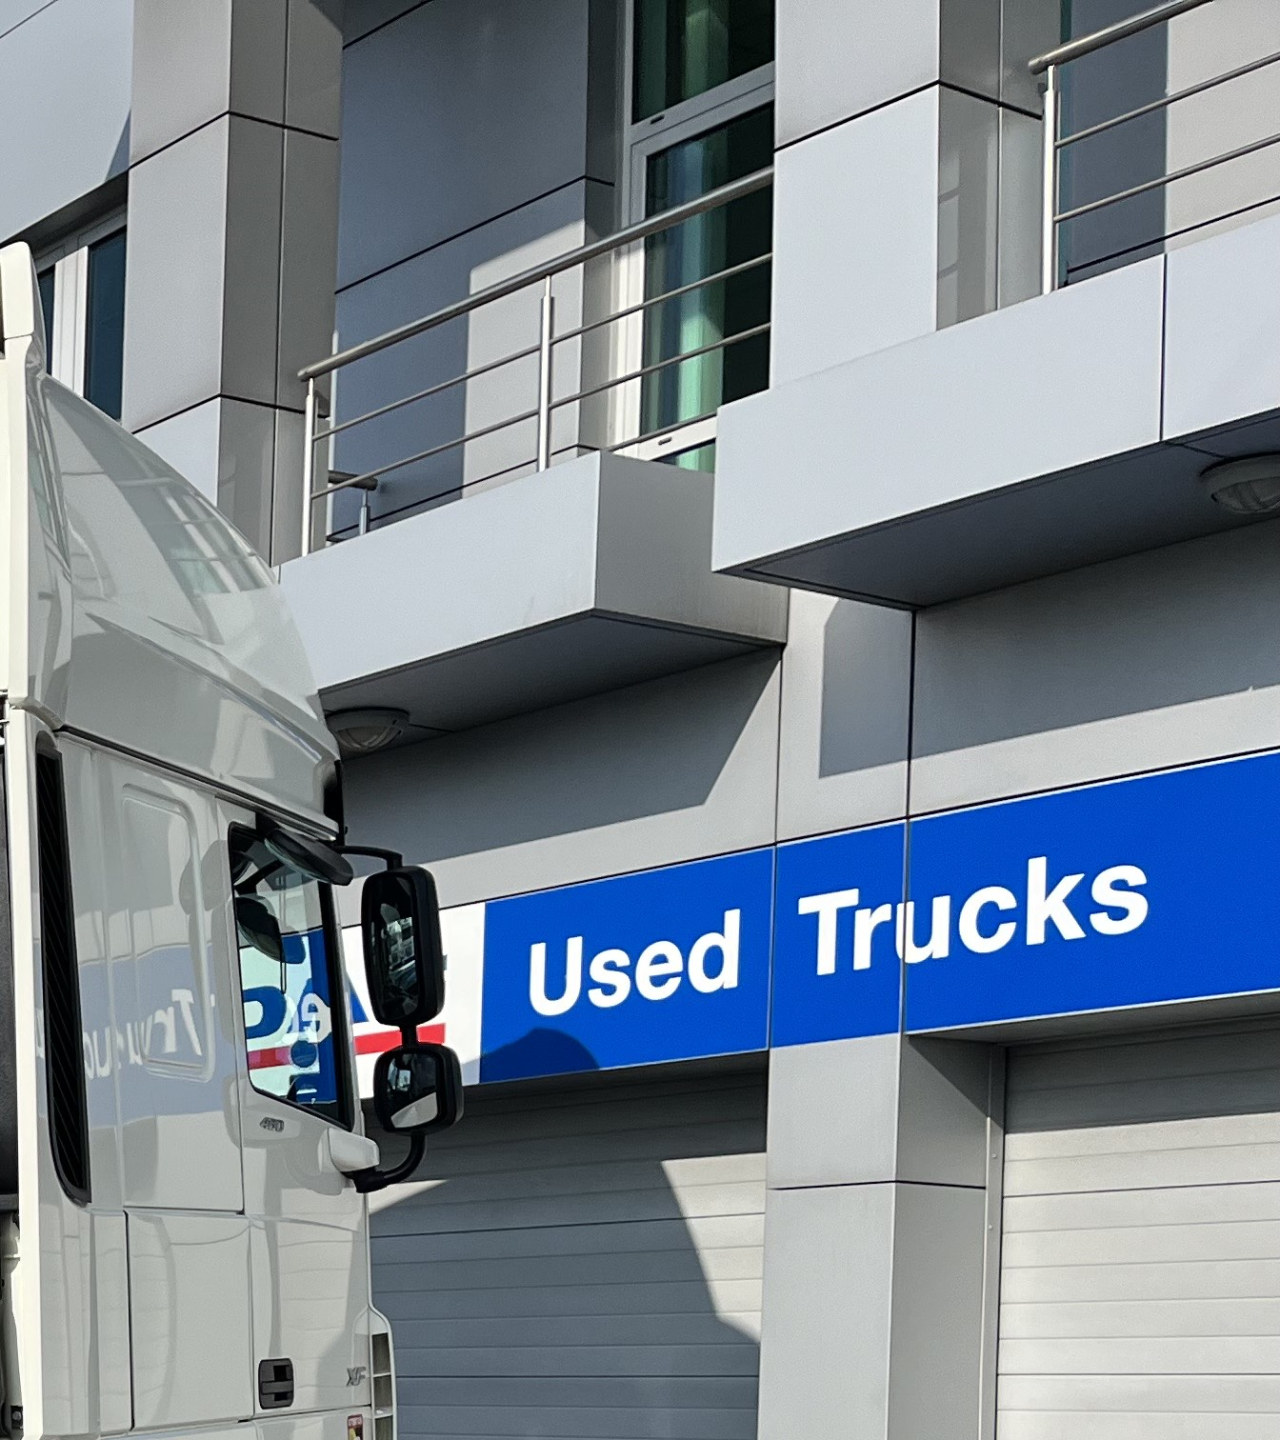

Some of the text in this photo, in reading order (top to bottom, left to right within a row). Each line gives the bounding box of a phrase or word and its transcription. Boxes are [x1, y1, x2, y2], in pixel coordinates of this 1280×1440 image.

[529, 908, 741, 1017] Used
[798, 856, 1149, 976] Trucks
[346, 1366, 366, 1386] XF
